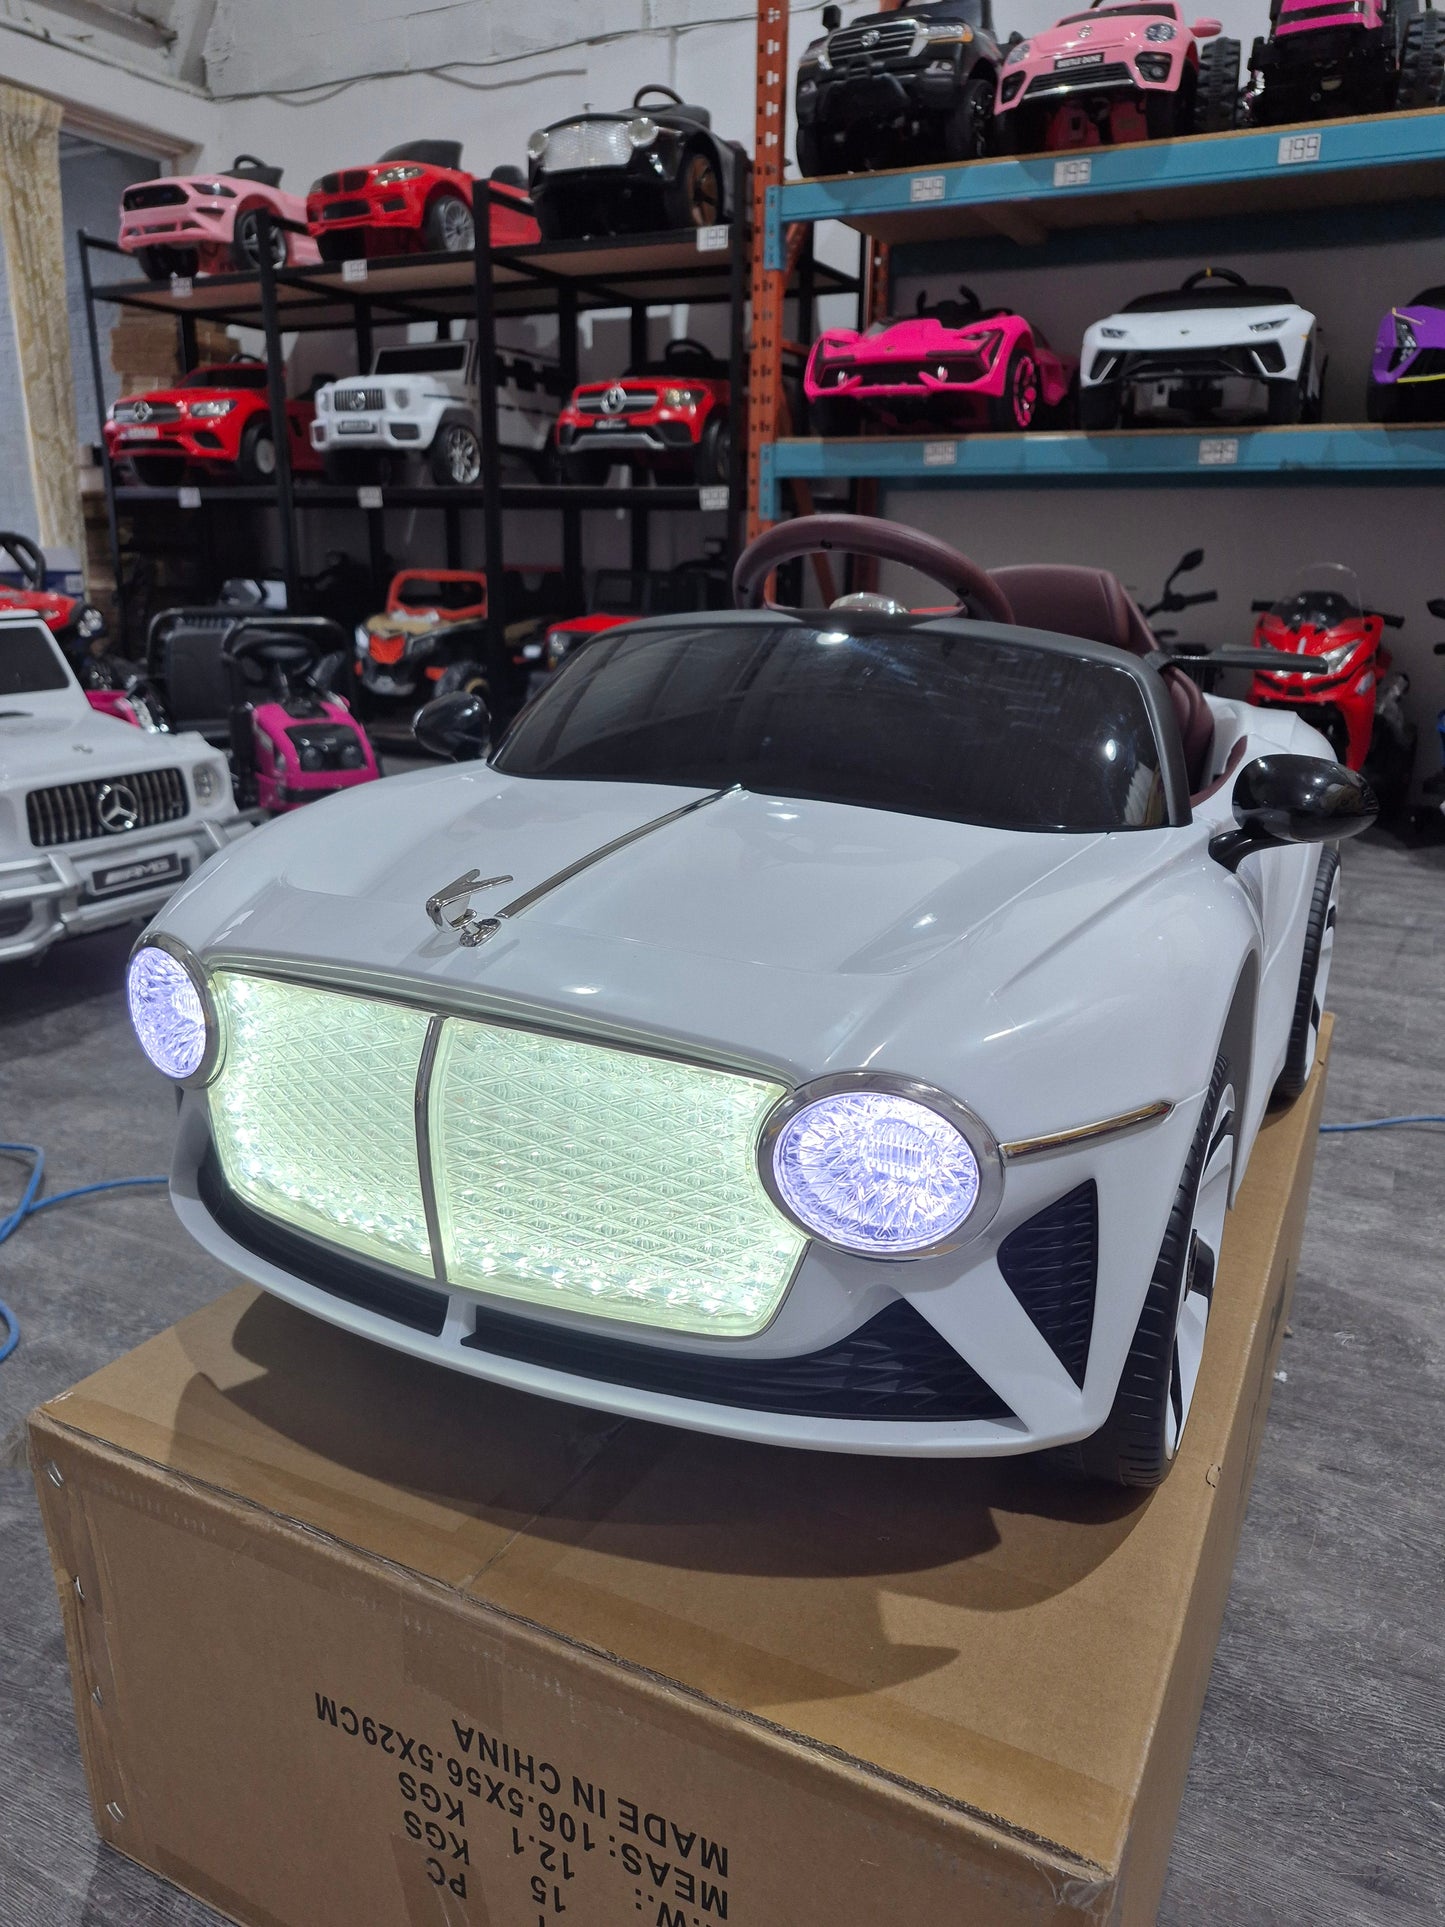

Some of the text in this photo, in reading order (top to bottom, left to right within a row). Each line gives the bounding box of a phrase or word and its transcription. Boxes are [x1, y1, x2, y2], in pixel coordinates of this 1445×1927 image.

[1062, 160, 1090, 183] 199
[1288, 136, 1319, 160] 199
[911, 177, 945, 199] 249
[315, 1692, 728, 1920] MEAS: 106.5X56.5X29CM
[398, 1771, 465, 1827] KGS
[452, 1719, 728, 1878] MADE IN CHINA
[403, 1810, 566, 1913] 15 KGS
[425, 1857, 467, 1900] PC
[512, 1826, 575, 1881] 12.1
